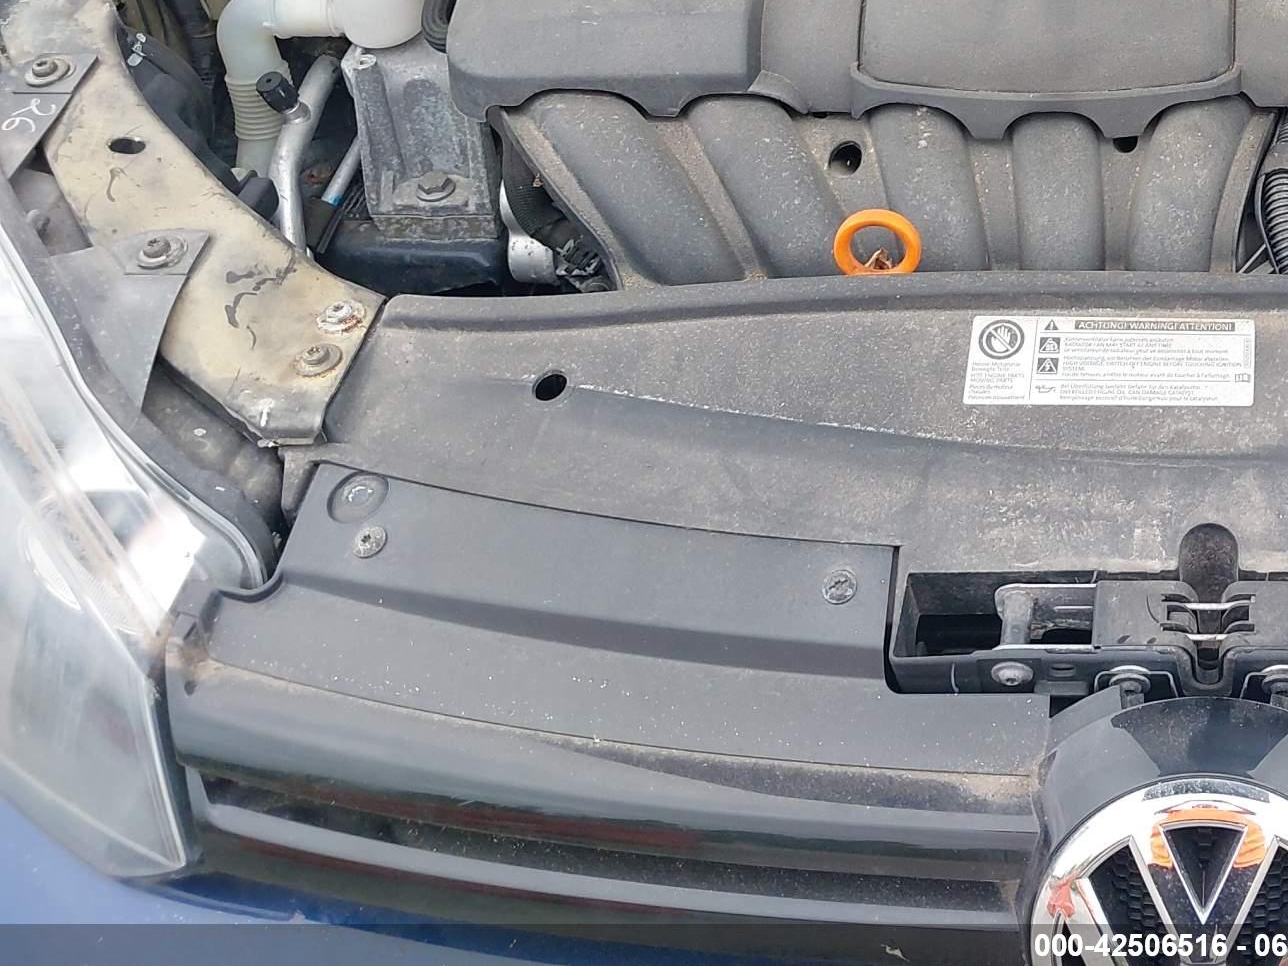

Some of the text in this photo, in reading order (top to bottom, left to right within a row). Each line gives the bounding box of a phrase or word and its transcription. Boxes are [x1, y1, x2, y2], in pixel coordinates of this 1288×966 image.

[1078, 321, 1232, 331] ACHTUNG! WARNING! ATTENTION!
